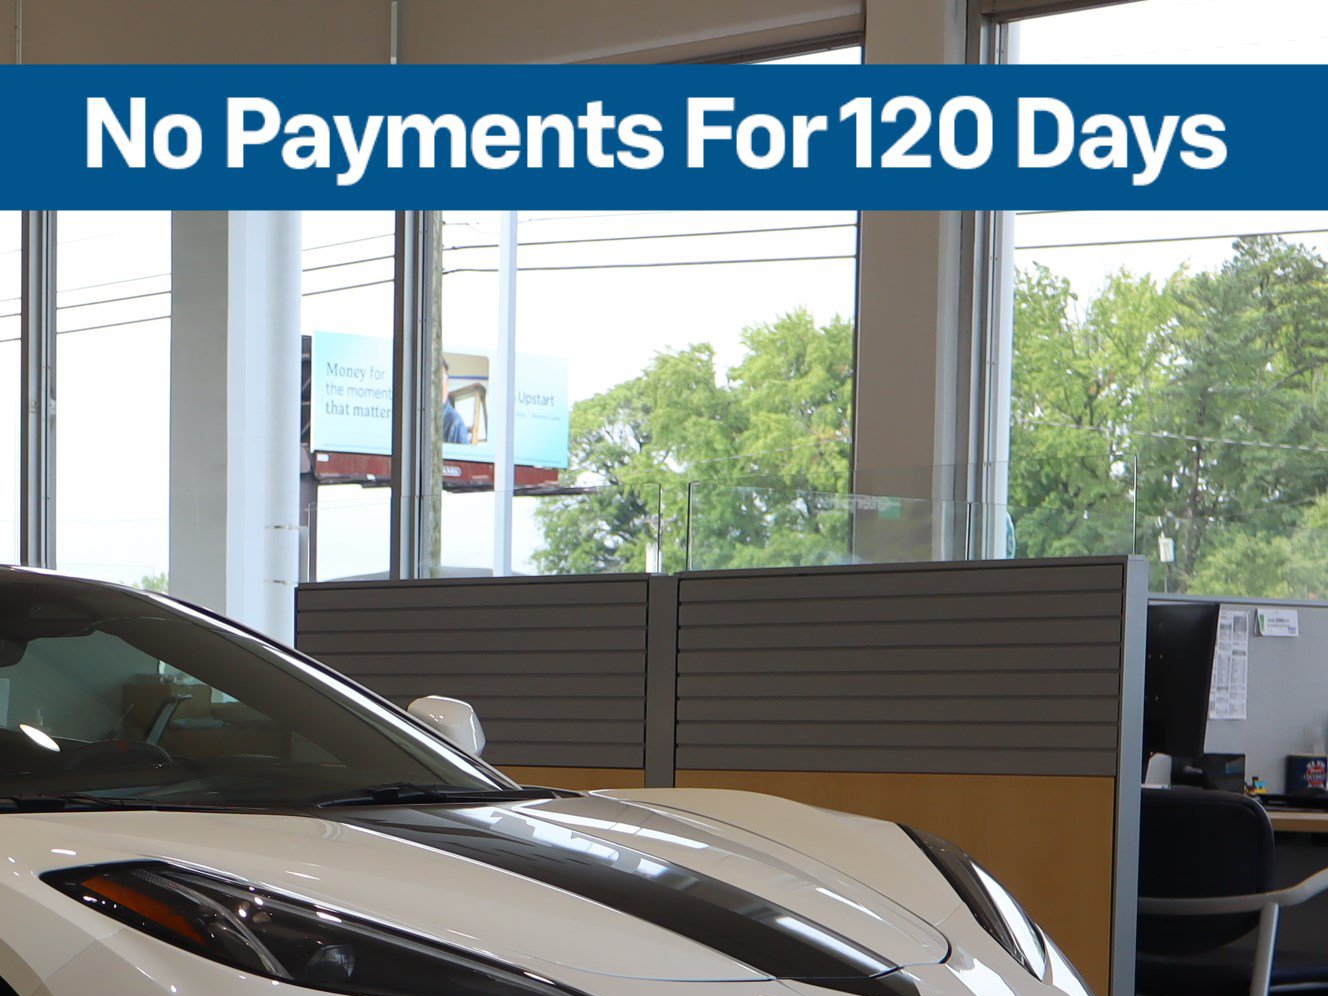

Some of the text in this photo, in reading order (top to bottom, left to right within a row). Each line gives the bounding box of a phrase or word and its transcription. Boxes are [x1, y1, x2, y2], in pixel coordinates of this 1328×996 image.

[326, 361, 385, 382] Money for
[326, 382, 344, 396] the
[517, 391, 555, 407] Upstart
[326, 400, 350, 416] that
